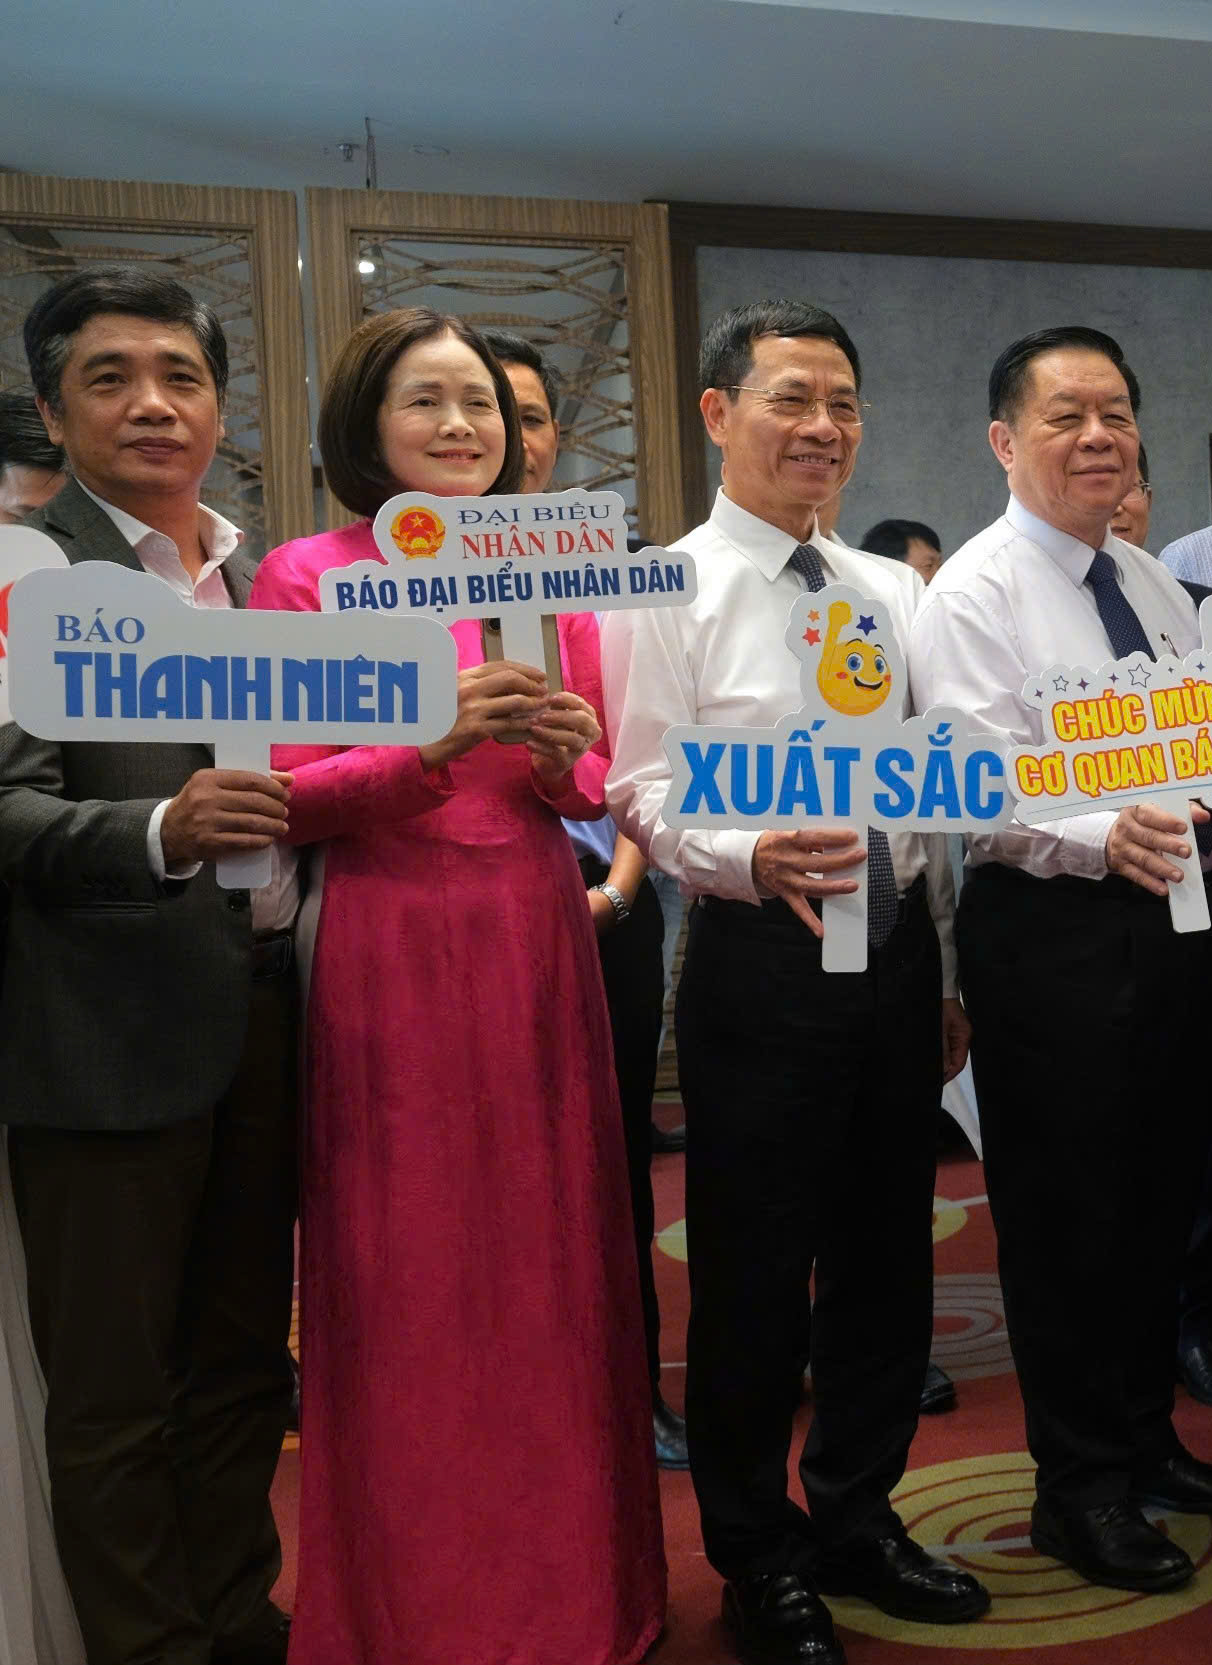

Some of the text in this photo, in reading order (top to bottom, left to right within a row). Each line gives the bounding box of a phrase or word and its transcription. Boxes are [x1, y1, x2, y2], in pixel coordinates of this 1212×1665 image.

[458, 501, 611, 526] ĐẠI BIỂU
[460, 521, 615, 559] NHÂN DÂN
[335, 559, 685, 613] BÁO ĐẠI BIỂU NHÂN DÂN
[54, 608, 145, 644] BÁO
[54, 650, 419, 724] THANH NIÊN
[1052, 688, 1147, 743] CHÚC
[679, 719, 1004, 820] XUẤT SẮC
[1015, 751, 1068, 797] CƠ
[1073, 742, 1169, 798] QUAN
